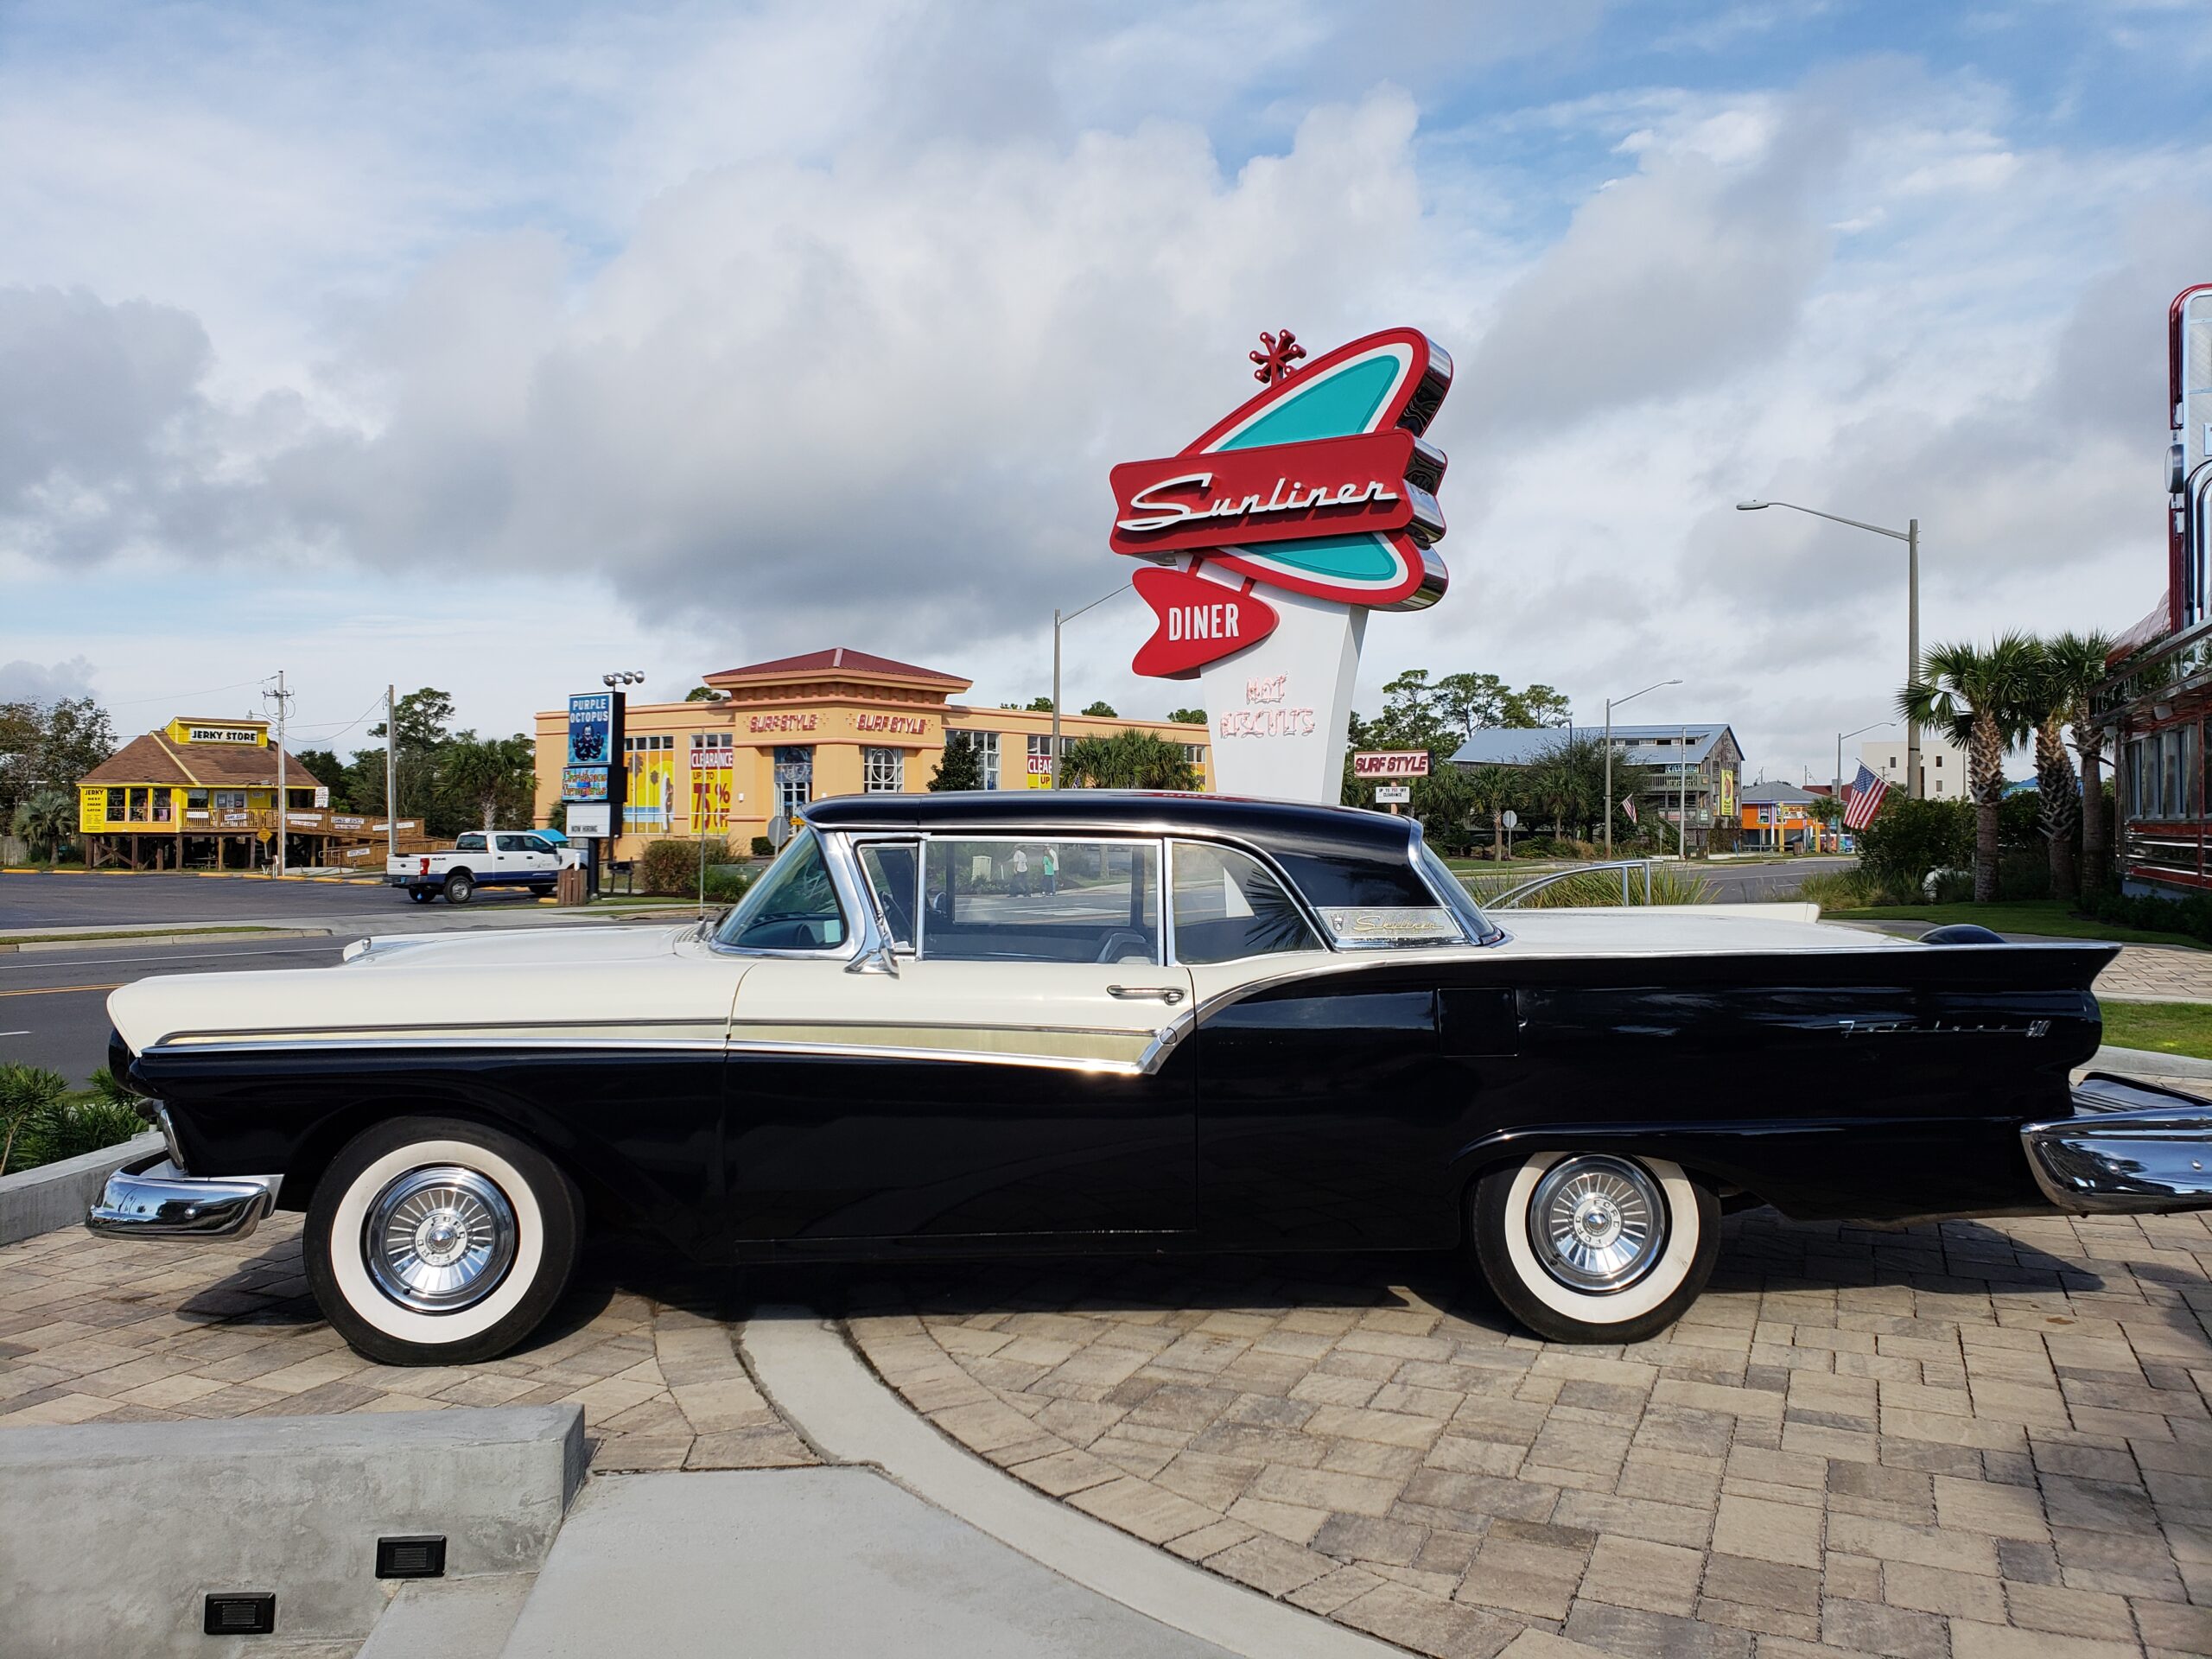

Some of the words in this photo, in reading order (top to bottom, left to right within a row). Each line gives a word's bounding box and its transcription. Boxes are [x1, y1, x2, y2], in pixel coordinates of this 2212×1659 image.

[1116, 472, 1401, 531] Sunliner
[1168, 603, 1240, 641] DINER
[1246, 674, 1287, 704] HOT
[572, 698, 607, 711] PURPLE
[569, 710, 608, 723] OCTOPUS
[749, 715, 779, 733] SURF
[780, 714, 818, 731] STYLE
[856, 714, 890, 731] SURF
[889, 717, 927, 734] STYLE
[1220, 709, 1315, 739] BISCUITS
[192, 730, 223, 740] JERKY
[226, 732, 256, 741] STORE
[691, 753, 733, 767] CLEARANCE
[1355, 757, 1385, 773] SURF
[1387, 756, 1427, 772] STYLE
[1667, 764, 1697, 772] PIERING
[1040, 776, 1050, 785] UP
[1353, 916, 1444, 932] Skyliner
[1593, 1200, 1620, 1228] FORD
[431, 1216, 466, 1239] FORD
